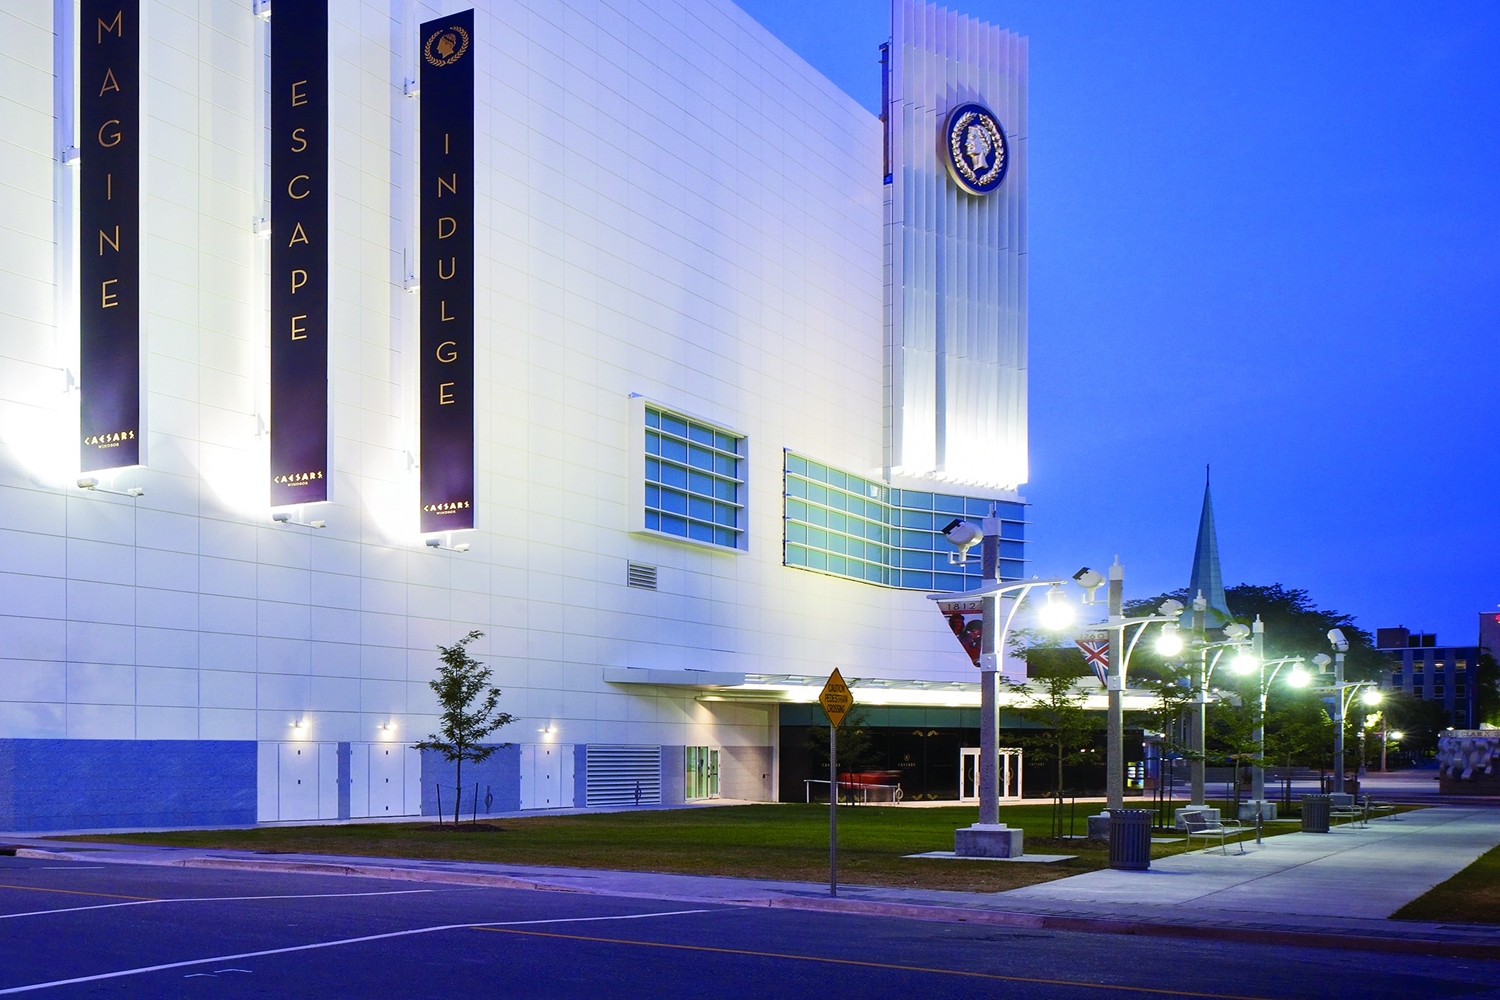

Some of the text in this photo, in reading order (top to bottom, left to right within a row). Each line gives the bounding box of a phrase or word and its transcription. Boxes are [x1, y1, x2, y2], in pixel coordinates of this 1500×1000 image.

[287, 79, 310, 341] ESCAPE
[435, 133, 458, 405] INDULGE
[84, 430, 134, 446] CAESARS
[273, 471, 323, 484] CAESARS
[423, 500, 470, 512] CAESARS
[947, 602, 976, 610] 1812
[828, 684, 846, 693] CAUTION
[824, 693, 848, 703] PEDESTRIAN
[827, 704, 846, 714] CROSSING
